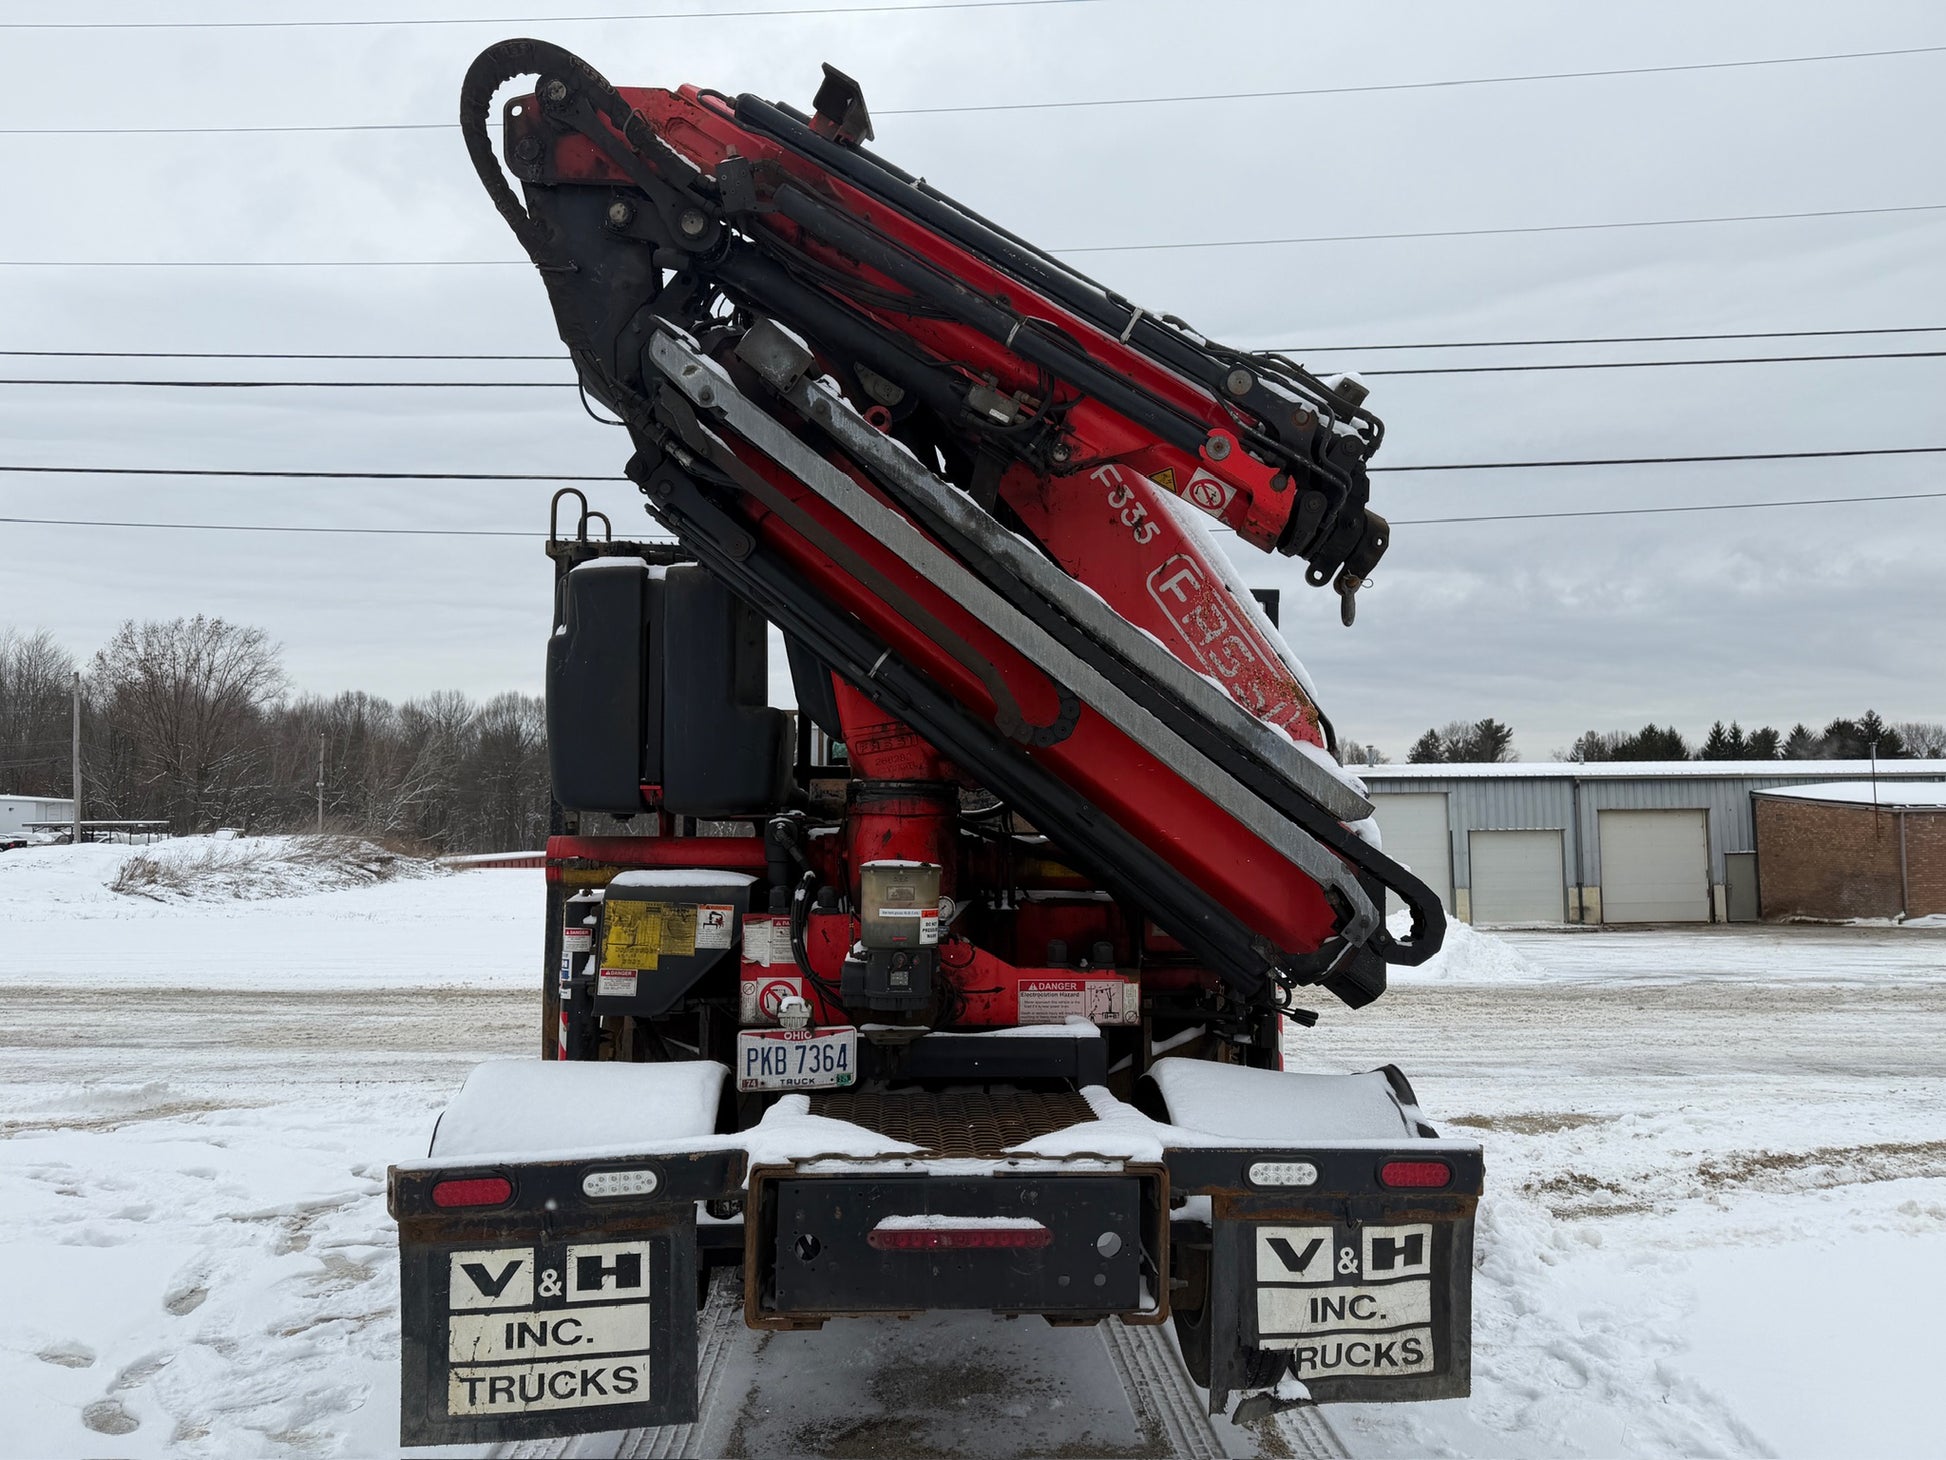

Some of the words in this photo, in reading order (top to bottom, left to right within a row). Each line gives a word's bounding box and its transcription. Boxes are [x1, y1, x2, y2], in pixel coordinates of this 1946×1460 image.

[1090, 464, 1160, 545] F335
[1038, 982, 1077, 990] DANGER
[783, 1030, 812, 1040] OHIO
[746, 1046, 787, 1077] PKB
[795, 1043, 848, 1074] 7364
[1265, 1237, 1325, 1273] V
[1337, 1246, 1359, 1275] &
[1371, 1233, 1423, 1271] H
[460, 1260, 523, 1298] V
[538, 1268, 562, 1298] &
[576, 1253, 641, 1292] H
[1309, 1294, 1387, 1325] INC.
[504, 1318, 594, 1351] INC.
[1295, 1337, 1425, 1373] RUCKS
[460, 1365, 639, 1407] TRUCKS
